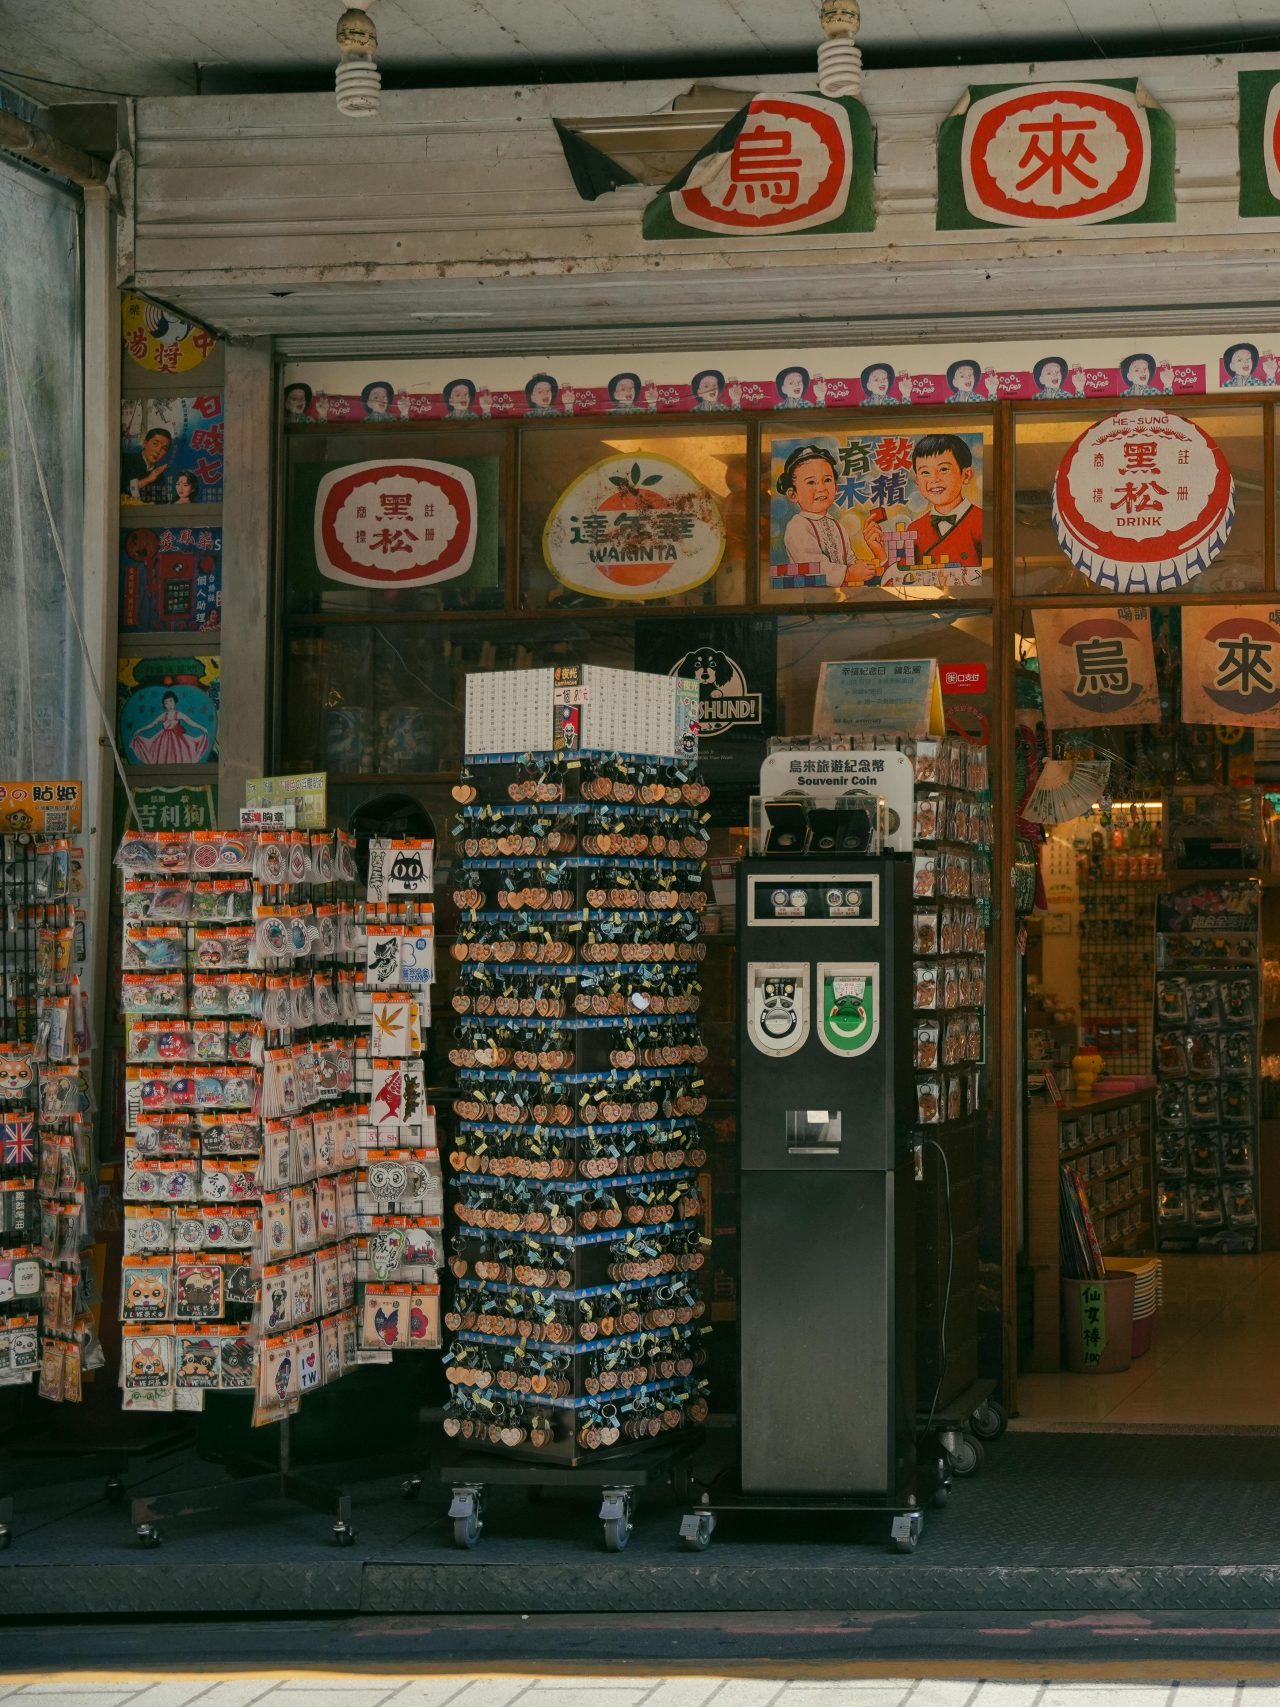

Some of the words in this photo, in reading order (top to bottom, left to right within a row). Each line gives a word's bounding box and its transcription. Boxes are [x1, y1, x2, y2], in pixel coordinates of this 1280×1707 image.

[722, 125, 803, 207] 烏
[1016, 112, 1098, 196] 來
[1112, 416, 1170, 426] HE-SUNG
[839, 437, 913, 476] 教育
[1092, 452, 1105, 504] 商標
[1110, 441, 1170, 514] 黑松
[835, 472, 909, 508] 積木
[369, 492, 419, 554] 黑松
[1116, 516, 1164, 527] DRINK
[1075, 639, 1129, 694] 烏
[1217, 636, 1272, 693] 來
[789, 760, 885, 773] 烏來旅遊紀念幣
[797, 776, 849, 785] Souvenir
[851, 776, 877, 785] Coin
[1082, 1287, 1101, 1348] 仙女棒
